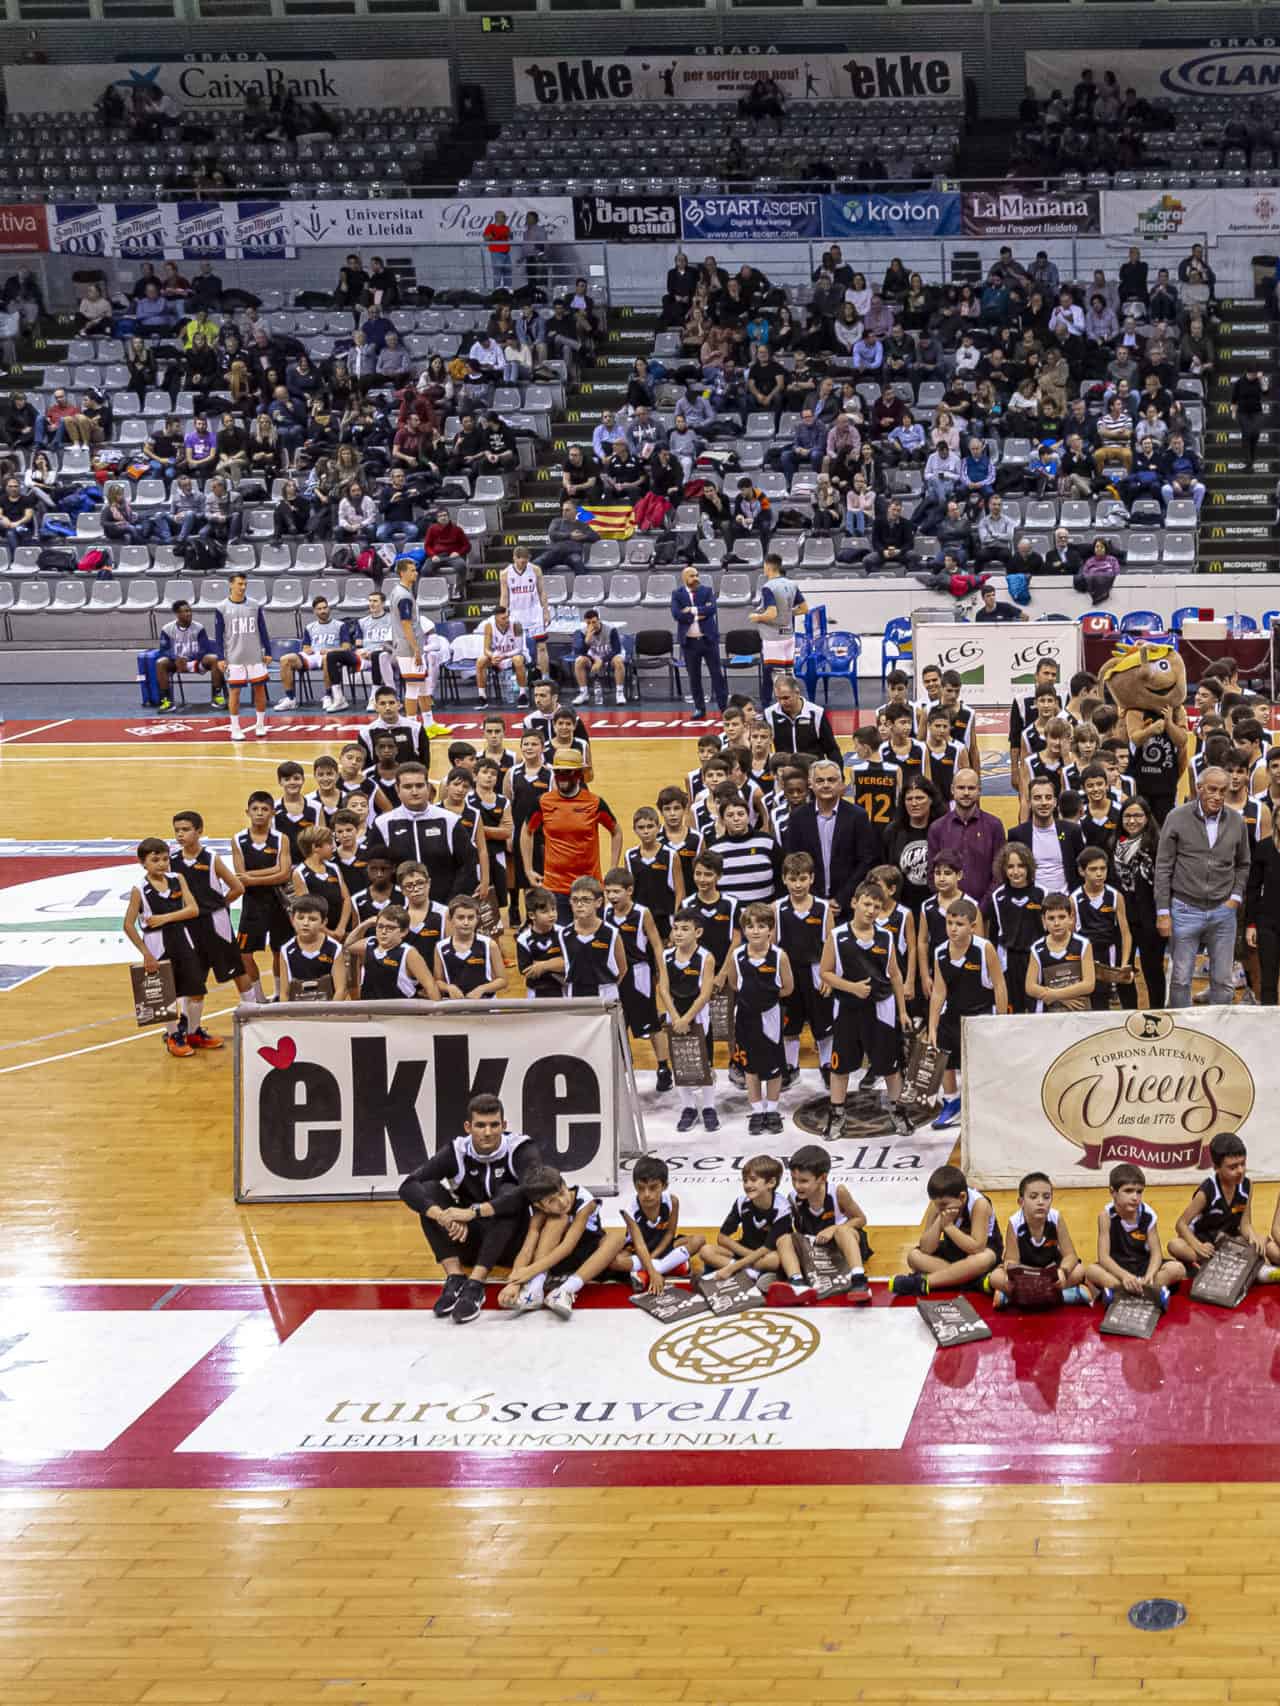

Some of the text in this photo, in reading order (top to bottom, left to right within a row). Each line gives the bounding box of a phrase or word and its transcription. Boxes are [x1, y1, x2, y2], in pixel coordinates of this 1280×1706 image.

[183, 52, 268, 62] GRADA
[694, 46, 780, 55] GRADA
[179, 68, 340, 98] CaixaBank
[345, 209, 425, 223] Universitat
[596, 204, 676, 223] dansa
[705, 199, 817, 215] START ASCENT
[867, 201, 941, 221] kroton
[972, 194, 1088, 220] La Mañana
[0, 211, 38, 233] tiva
[346, 223, 414, 237] de Lleida
[628, 221, 677, 235] estudi
[730, 218, 792, 228] Digital Marketing
[936, 640, 984, 668] ICG
[1011, 640, 1060, 669] ICG
[856, 792, 892, 824] 12
[258, 1033, 602, 1181] ekke
[1057, 1064, 1243, 1134] Vicens
[1151, 1113, 1176, 1125] 1775
[1106, 1144, 1194, 1163] AGRAMUNT
